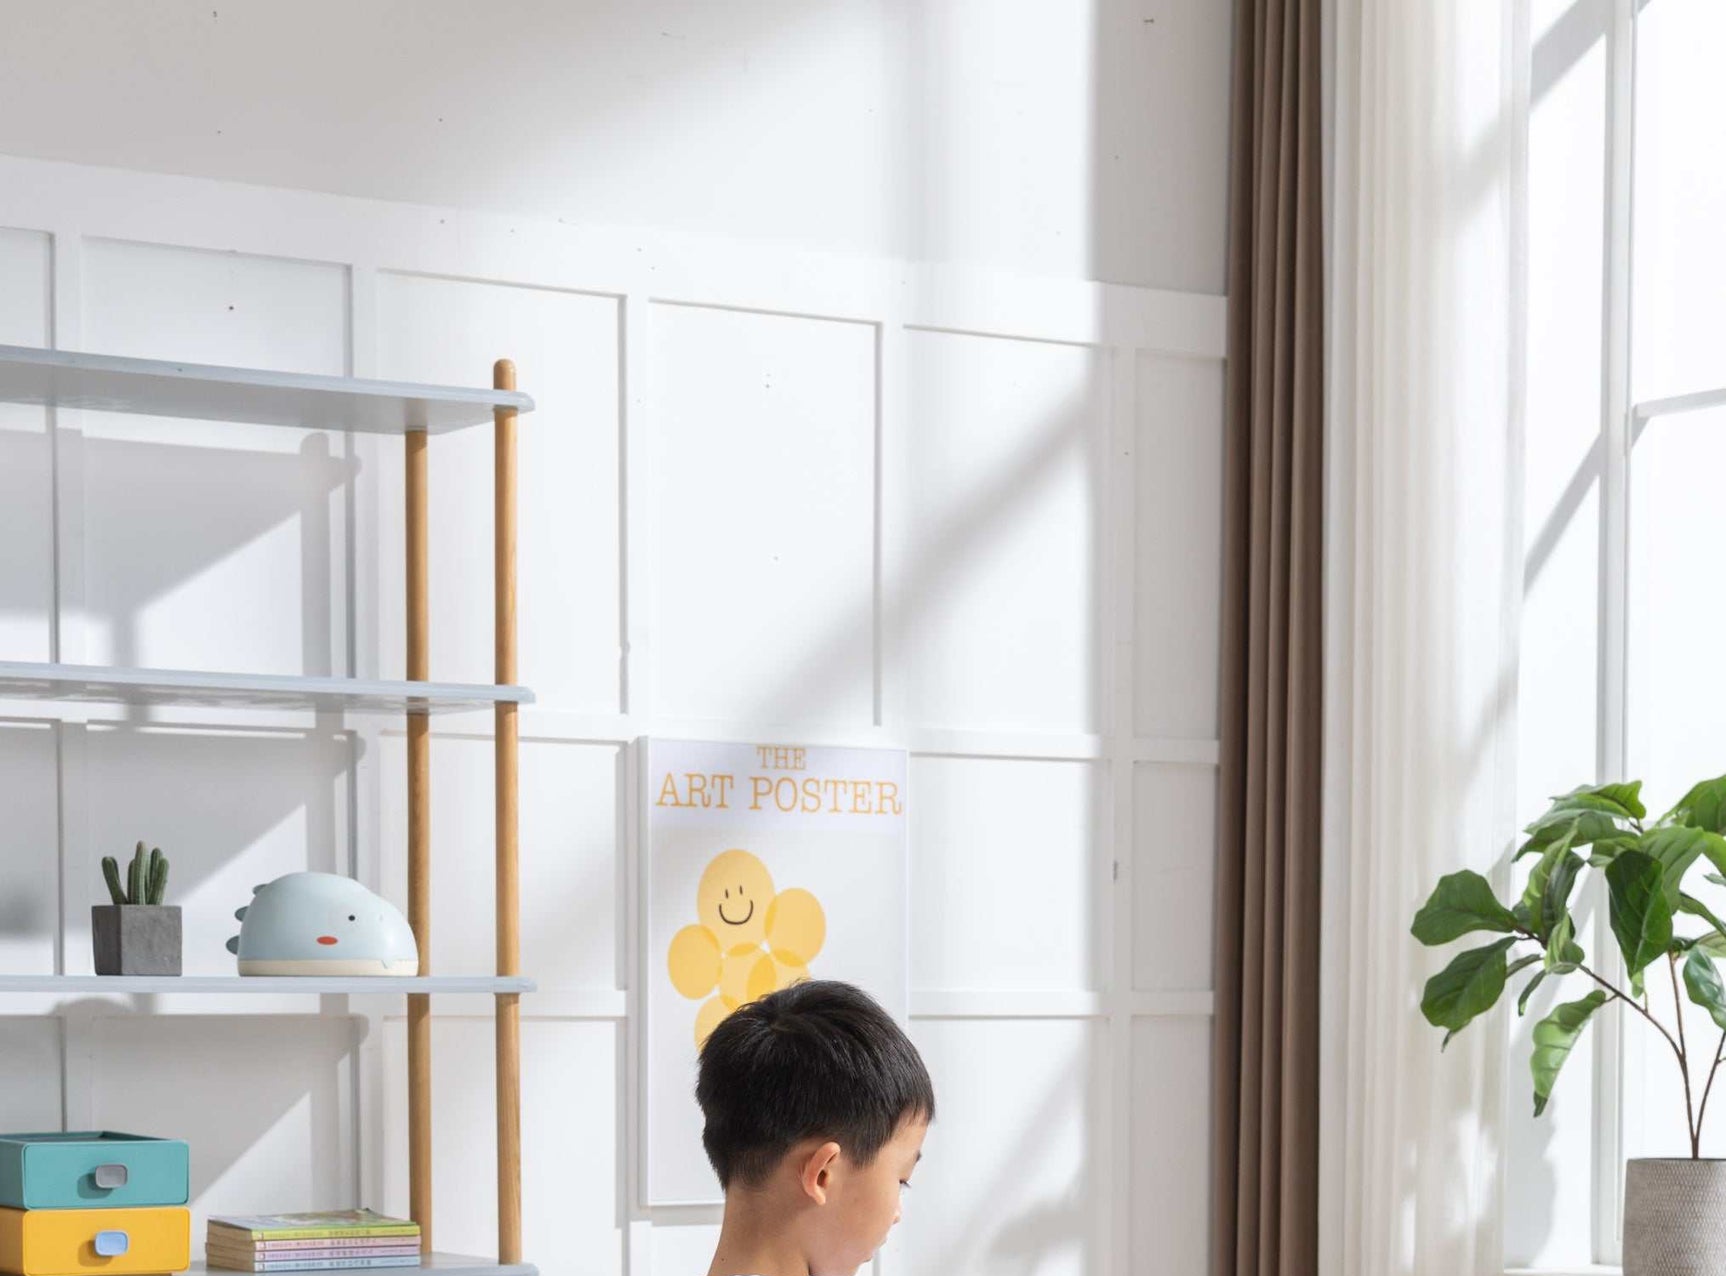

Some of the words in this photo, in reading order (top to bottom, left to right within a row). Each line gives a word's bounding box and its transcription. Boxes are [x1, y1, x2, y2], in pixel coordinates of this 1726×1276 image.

[756, 745, 806, 770] THE
[656, 773, 734, 809] ART
[748, 776, 903, 815] POSTER
